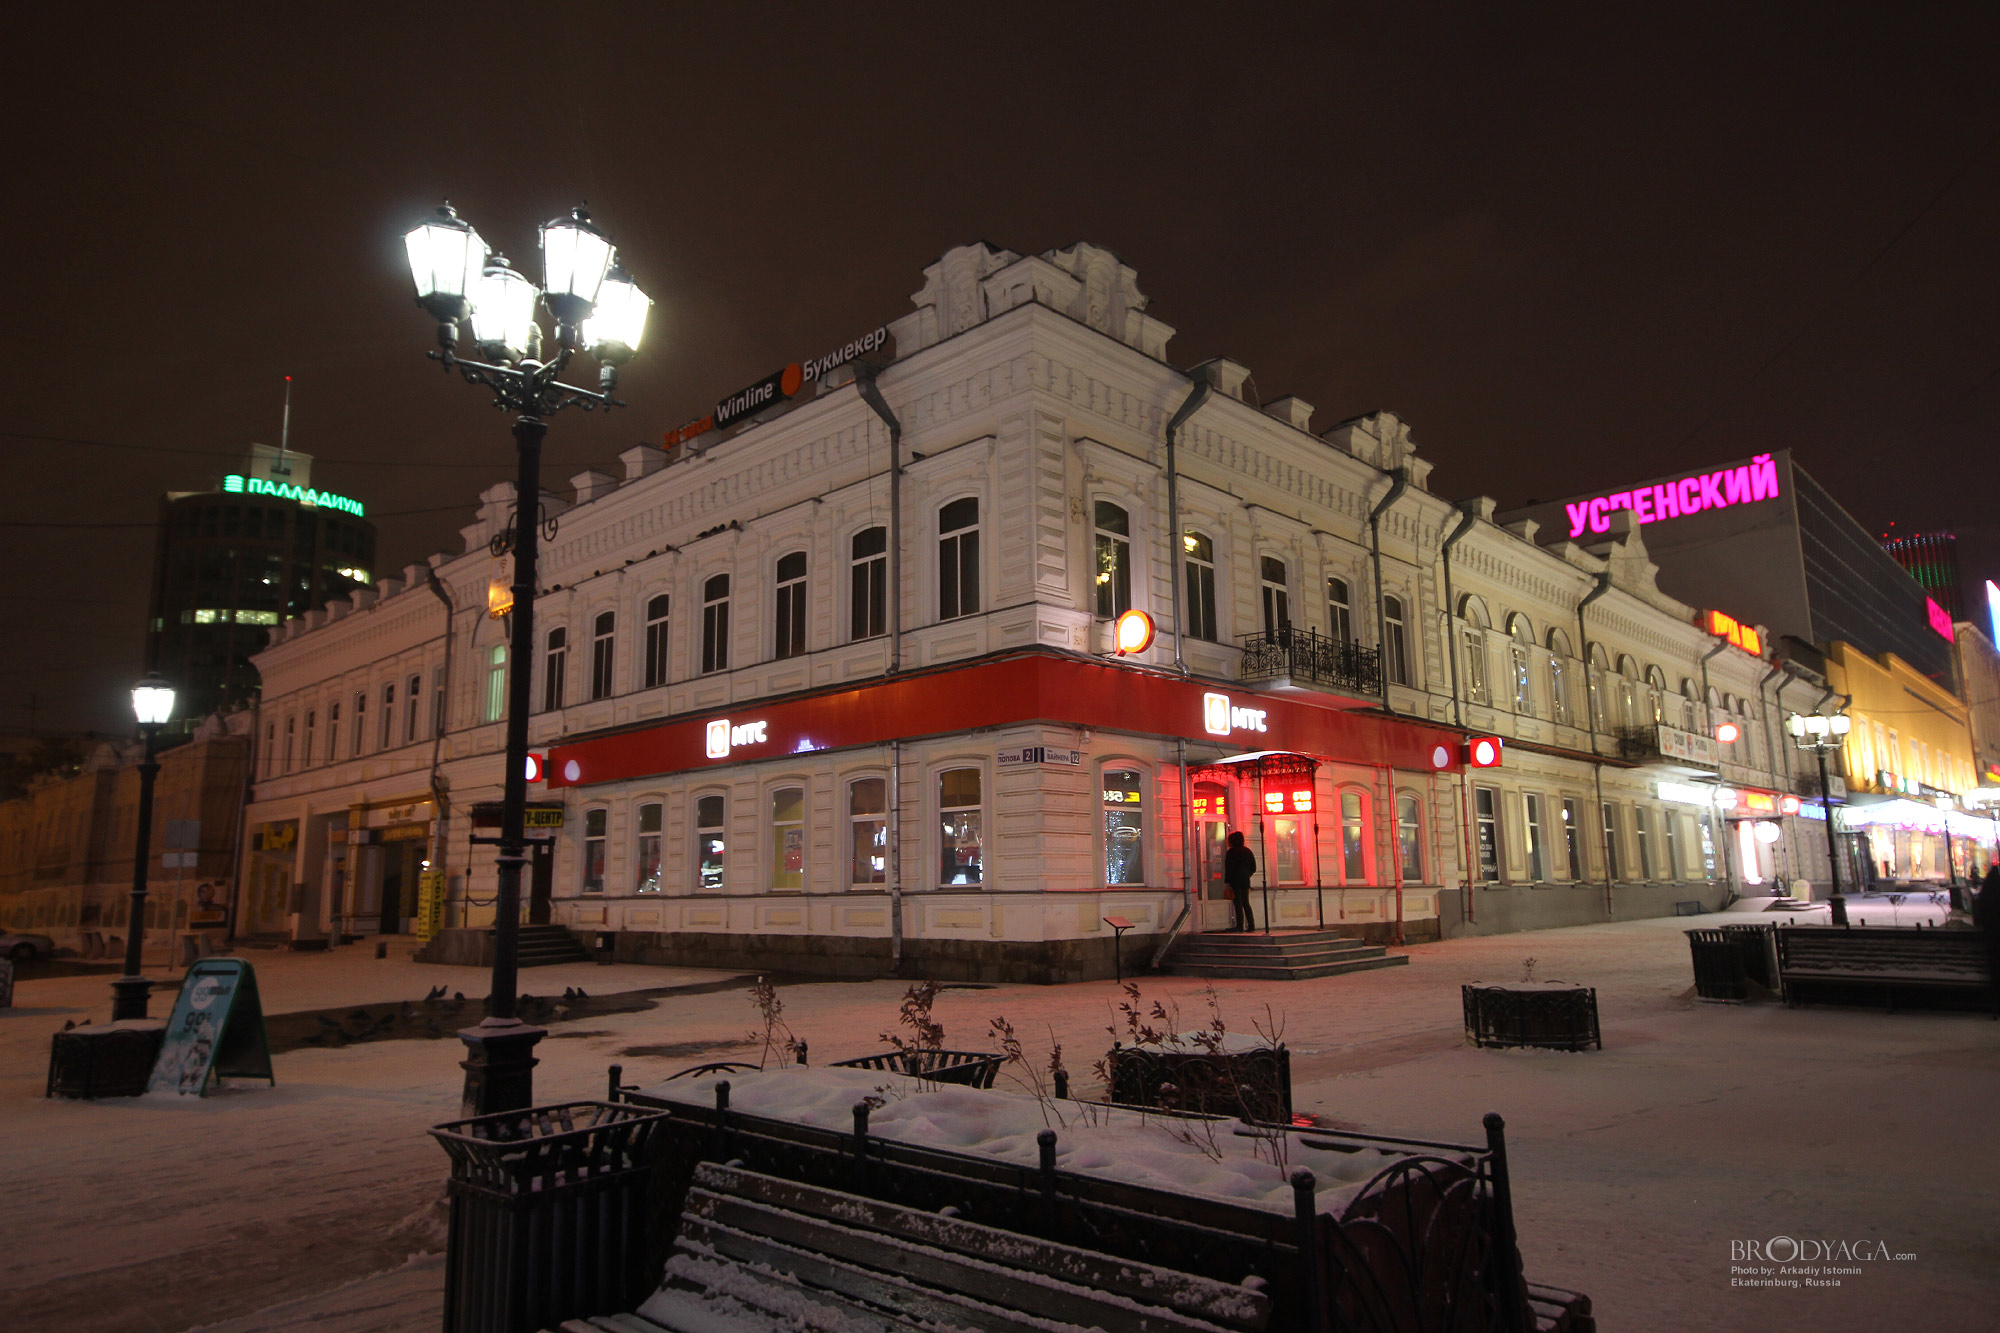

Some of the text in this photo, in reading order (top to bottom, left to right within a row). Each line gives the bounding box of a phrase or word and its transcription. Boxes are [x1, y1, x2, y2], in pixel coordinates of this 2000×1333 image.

[803, 326, 887, 382] Букмекер
[716, 382, 774, 422] Winline
[248, 477, 364, 518] ПАЛЛАДИУМ
[1231, 706, 1268, 733] МТС
[731, 720, 767, 747] МТС
[998, 754, 1020, 763] ПОПОВА
[1046, 752, 1080, 764] ВАЙНЕРА 12
